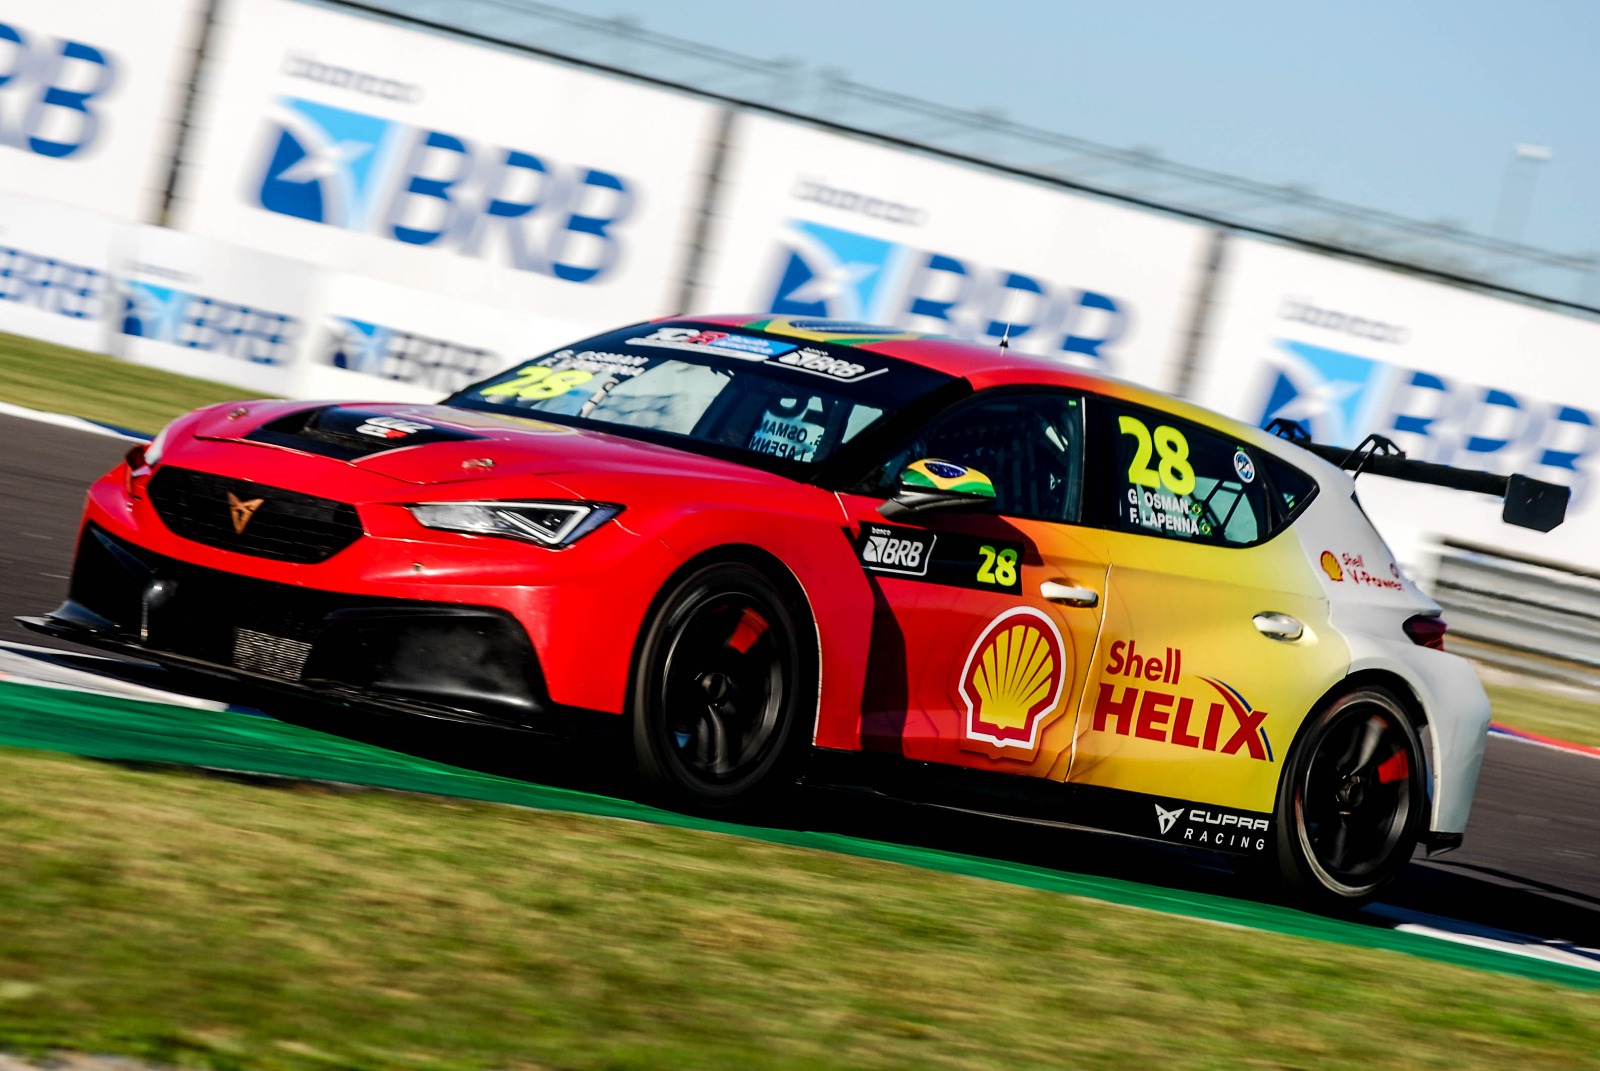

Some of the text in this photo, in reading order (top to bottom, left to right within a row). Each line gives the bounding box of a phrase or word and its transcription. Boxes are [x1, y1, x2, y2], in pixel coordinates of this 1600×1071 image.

[385, 127, 639, 284] BRB
[808, 353, 866, 378] BRB
[479, 366, 593, 399] 28
[1118, 416, 1196, 495] 28
[1128, 488, 1189, 514] G. OSMAN
[871, 526, 892, 536] banco
[1129, 508, 1199, 535] F. LAPENNA
[883, 538, 924, 568] BRB
[976, 545, 1018, 587] 28
[1342, 552, 1364, 568] Shell
[1106, 639, 1181, 685] Shell
[1092, 676, 1270, 762] HELIX
[1189, 809, 1269, 832] CUPRA
[1184, 828, 1265, 851] RACING
